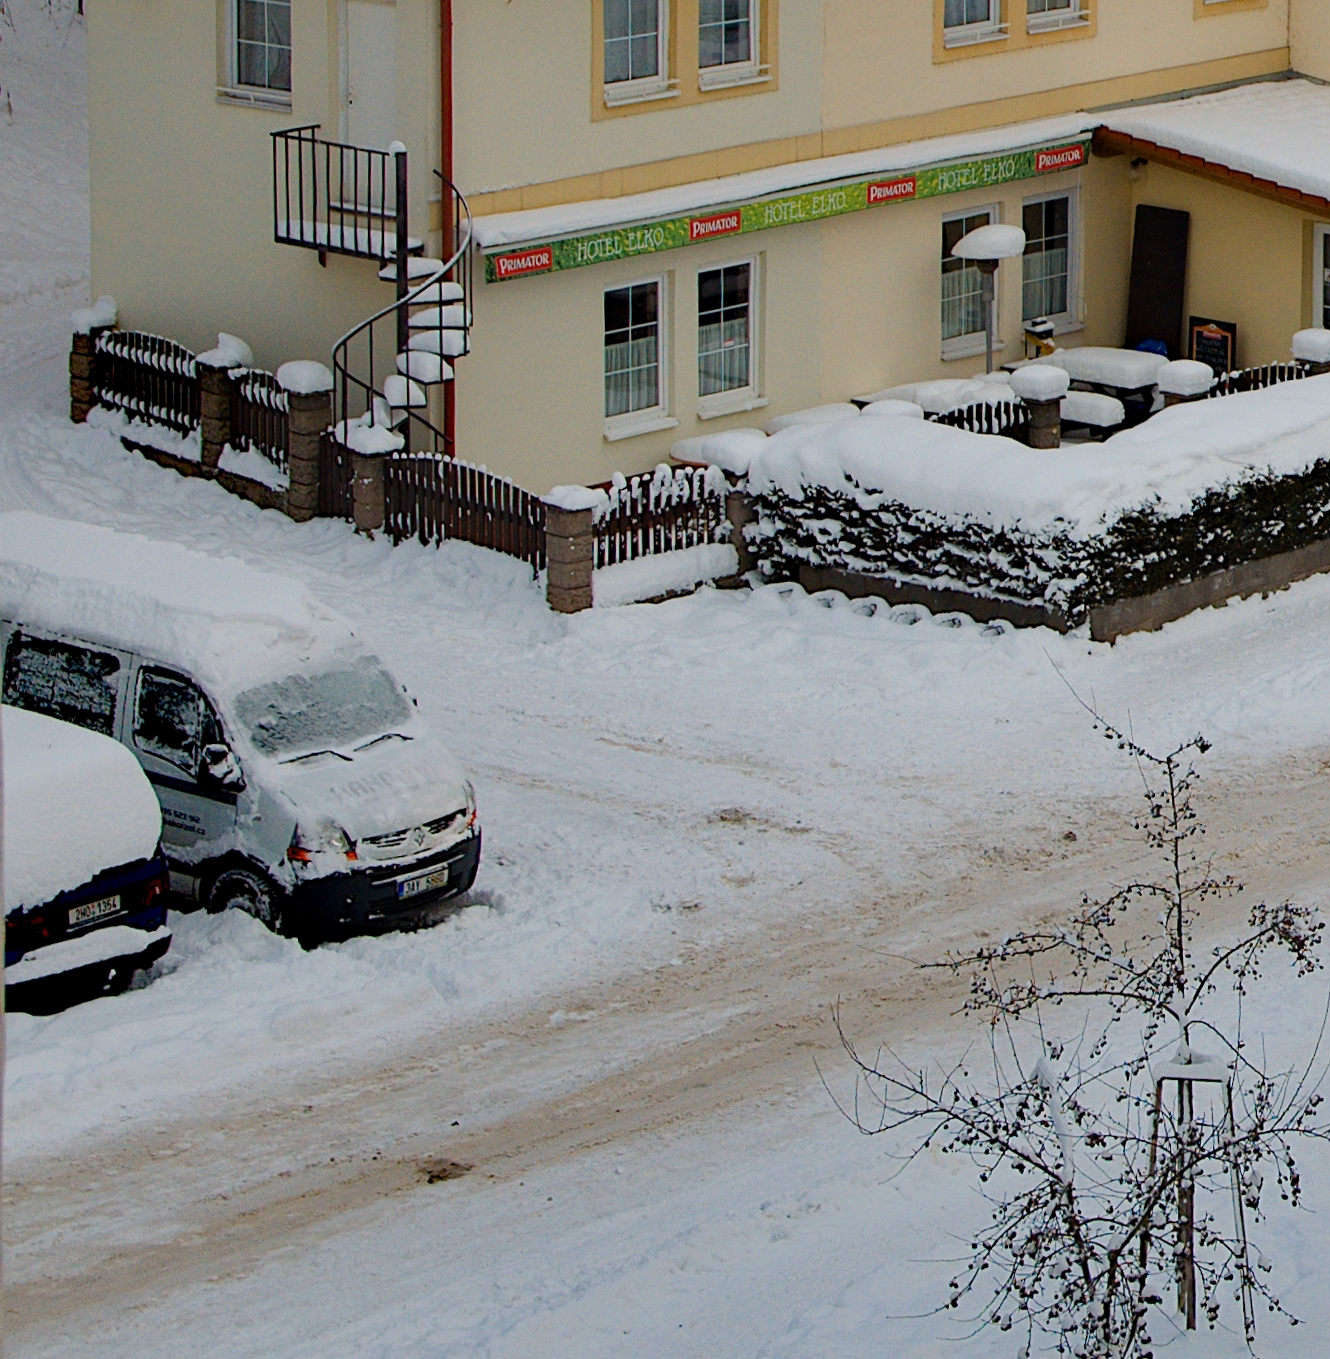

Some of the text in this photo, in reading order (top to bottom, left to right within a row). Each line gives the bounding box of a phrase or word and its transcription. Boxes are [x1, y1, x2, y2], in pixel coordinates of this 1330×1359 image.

[498, 147, 1083, 275] PRIMATOR HOTEL ELKO PRIMATOR HOTEL ELKO PRIMATOR HOTEL ELKO PRIMATOR
[97, 897, 117, 913] 1354
